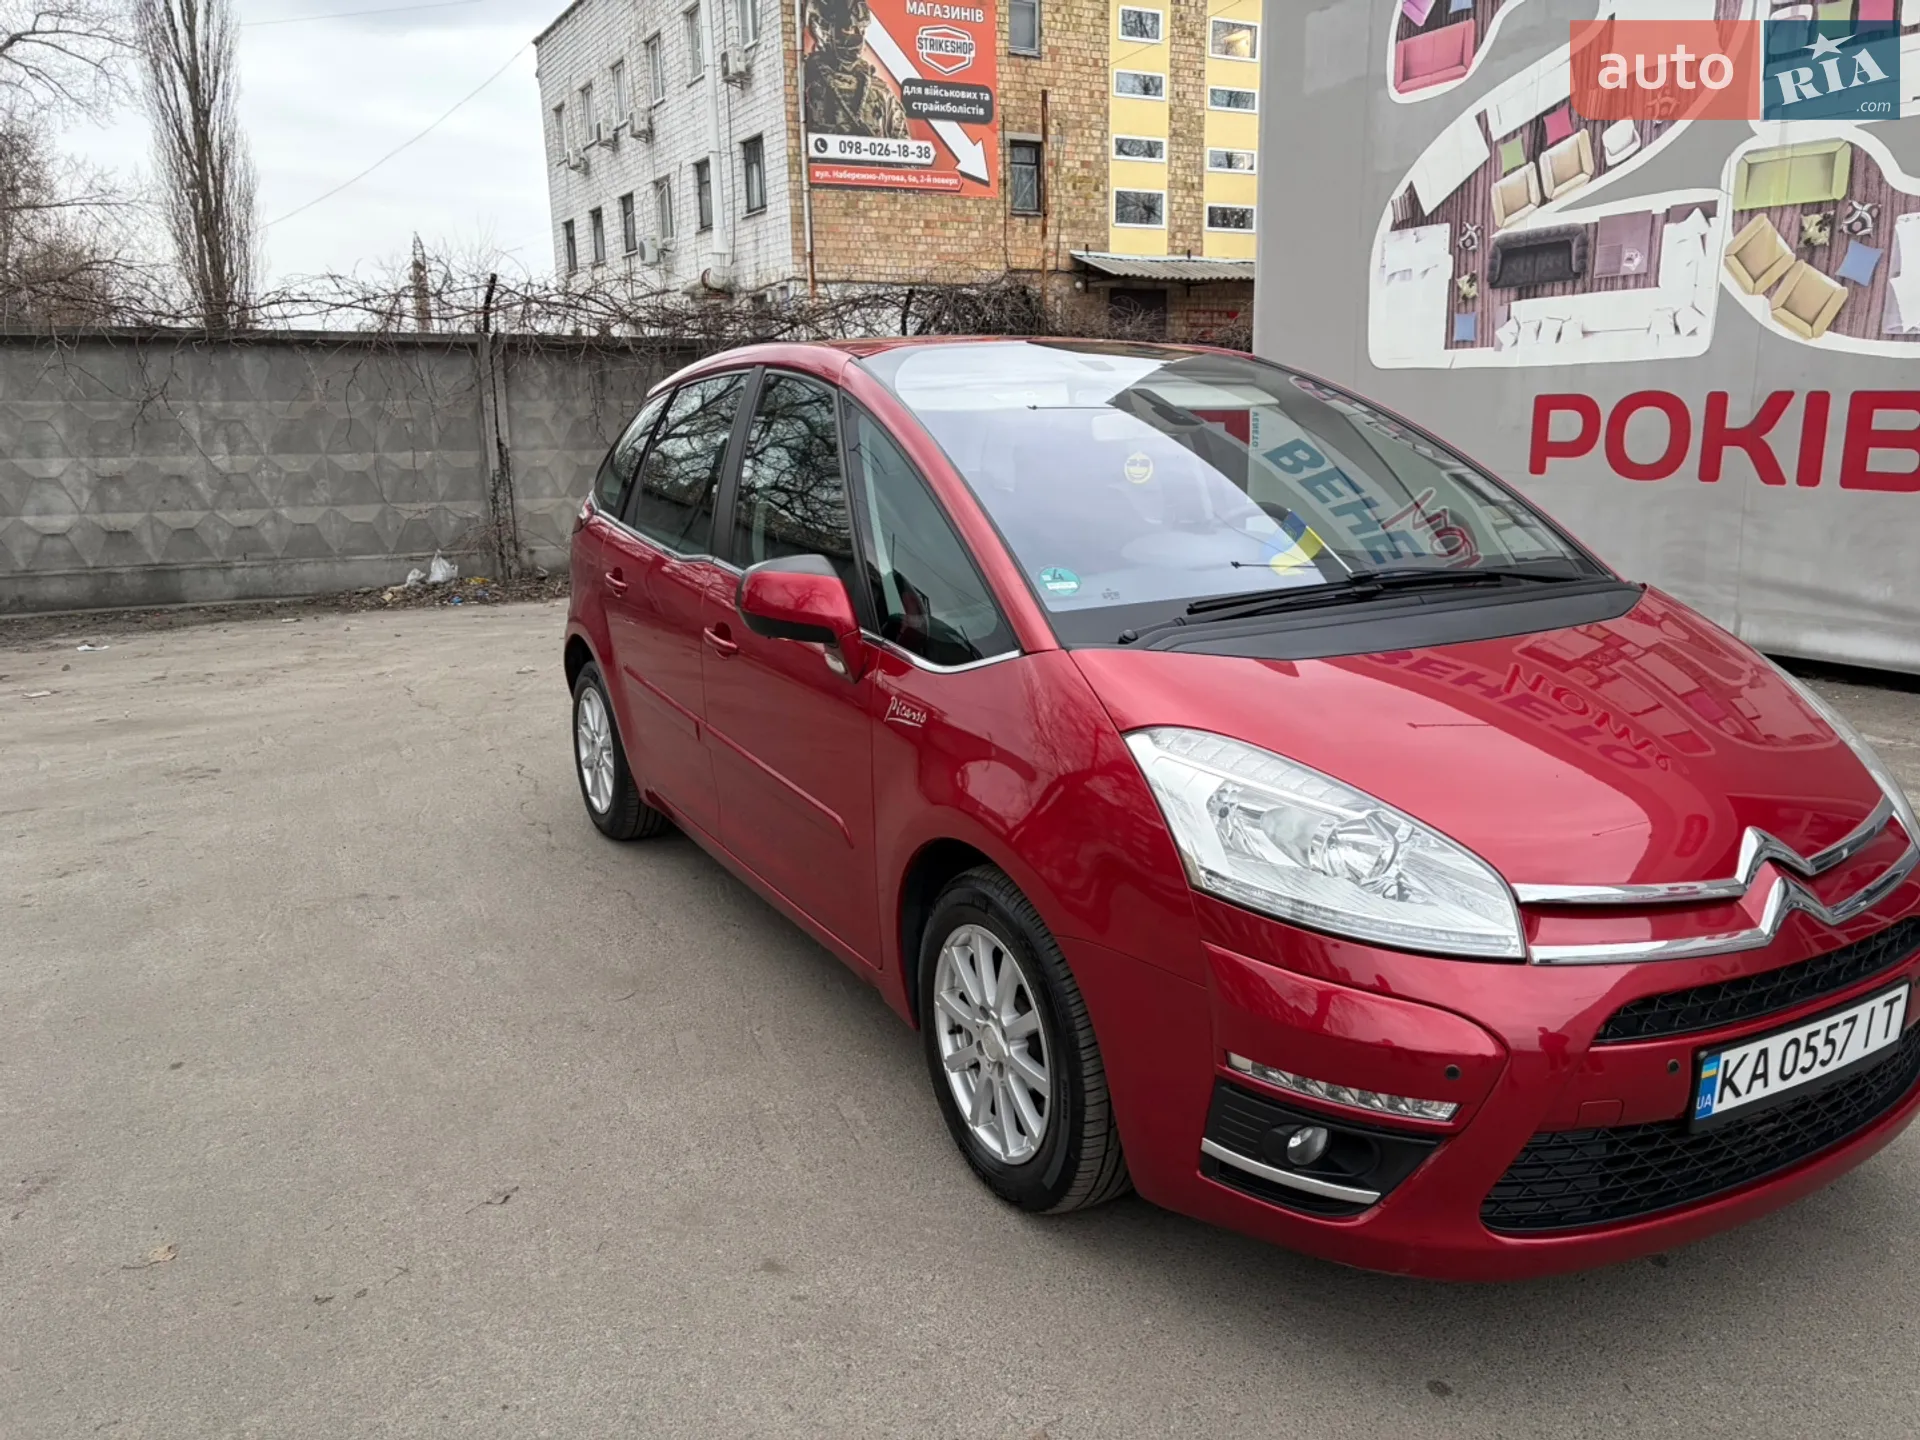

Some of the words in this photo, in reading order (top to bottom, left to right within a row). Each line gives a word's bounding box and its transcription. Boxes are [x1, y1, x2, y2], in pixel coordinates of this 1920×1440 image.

[906, 0, 984, 23] МАГАЗИНІВ
[917, 37, 974, 55] STRIKESHOP
[903, 86, 922, 98] для
[924, 86, 978, 100] військових
[979, 92, 990, 101] та
[912, 101, 985, 115] страйкболістів
[838, 140, 931, 159] 098-026-18-38
[814, 170, 831, 180] вул.
[919, 174, 932, 184] 2-й
[932, 177, 959, 187] поверх
[1528, 390, 1920, 493] РОКІВ
[883, 696, 927, 726] Picasso
[1717, 1046, 1769, 1104] KA
[1778, 1014, 1859, 1082] 0557
[1863, 993, 1903, 1048] IT
[1696, 1098, 1712, 1110] UA
